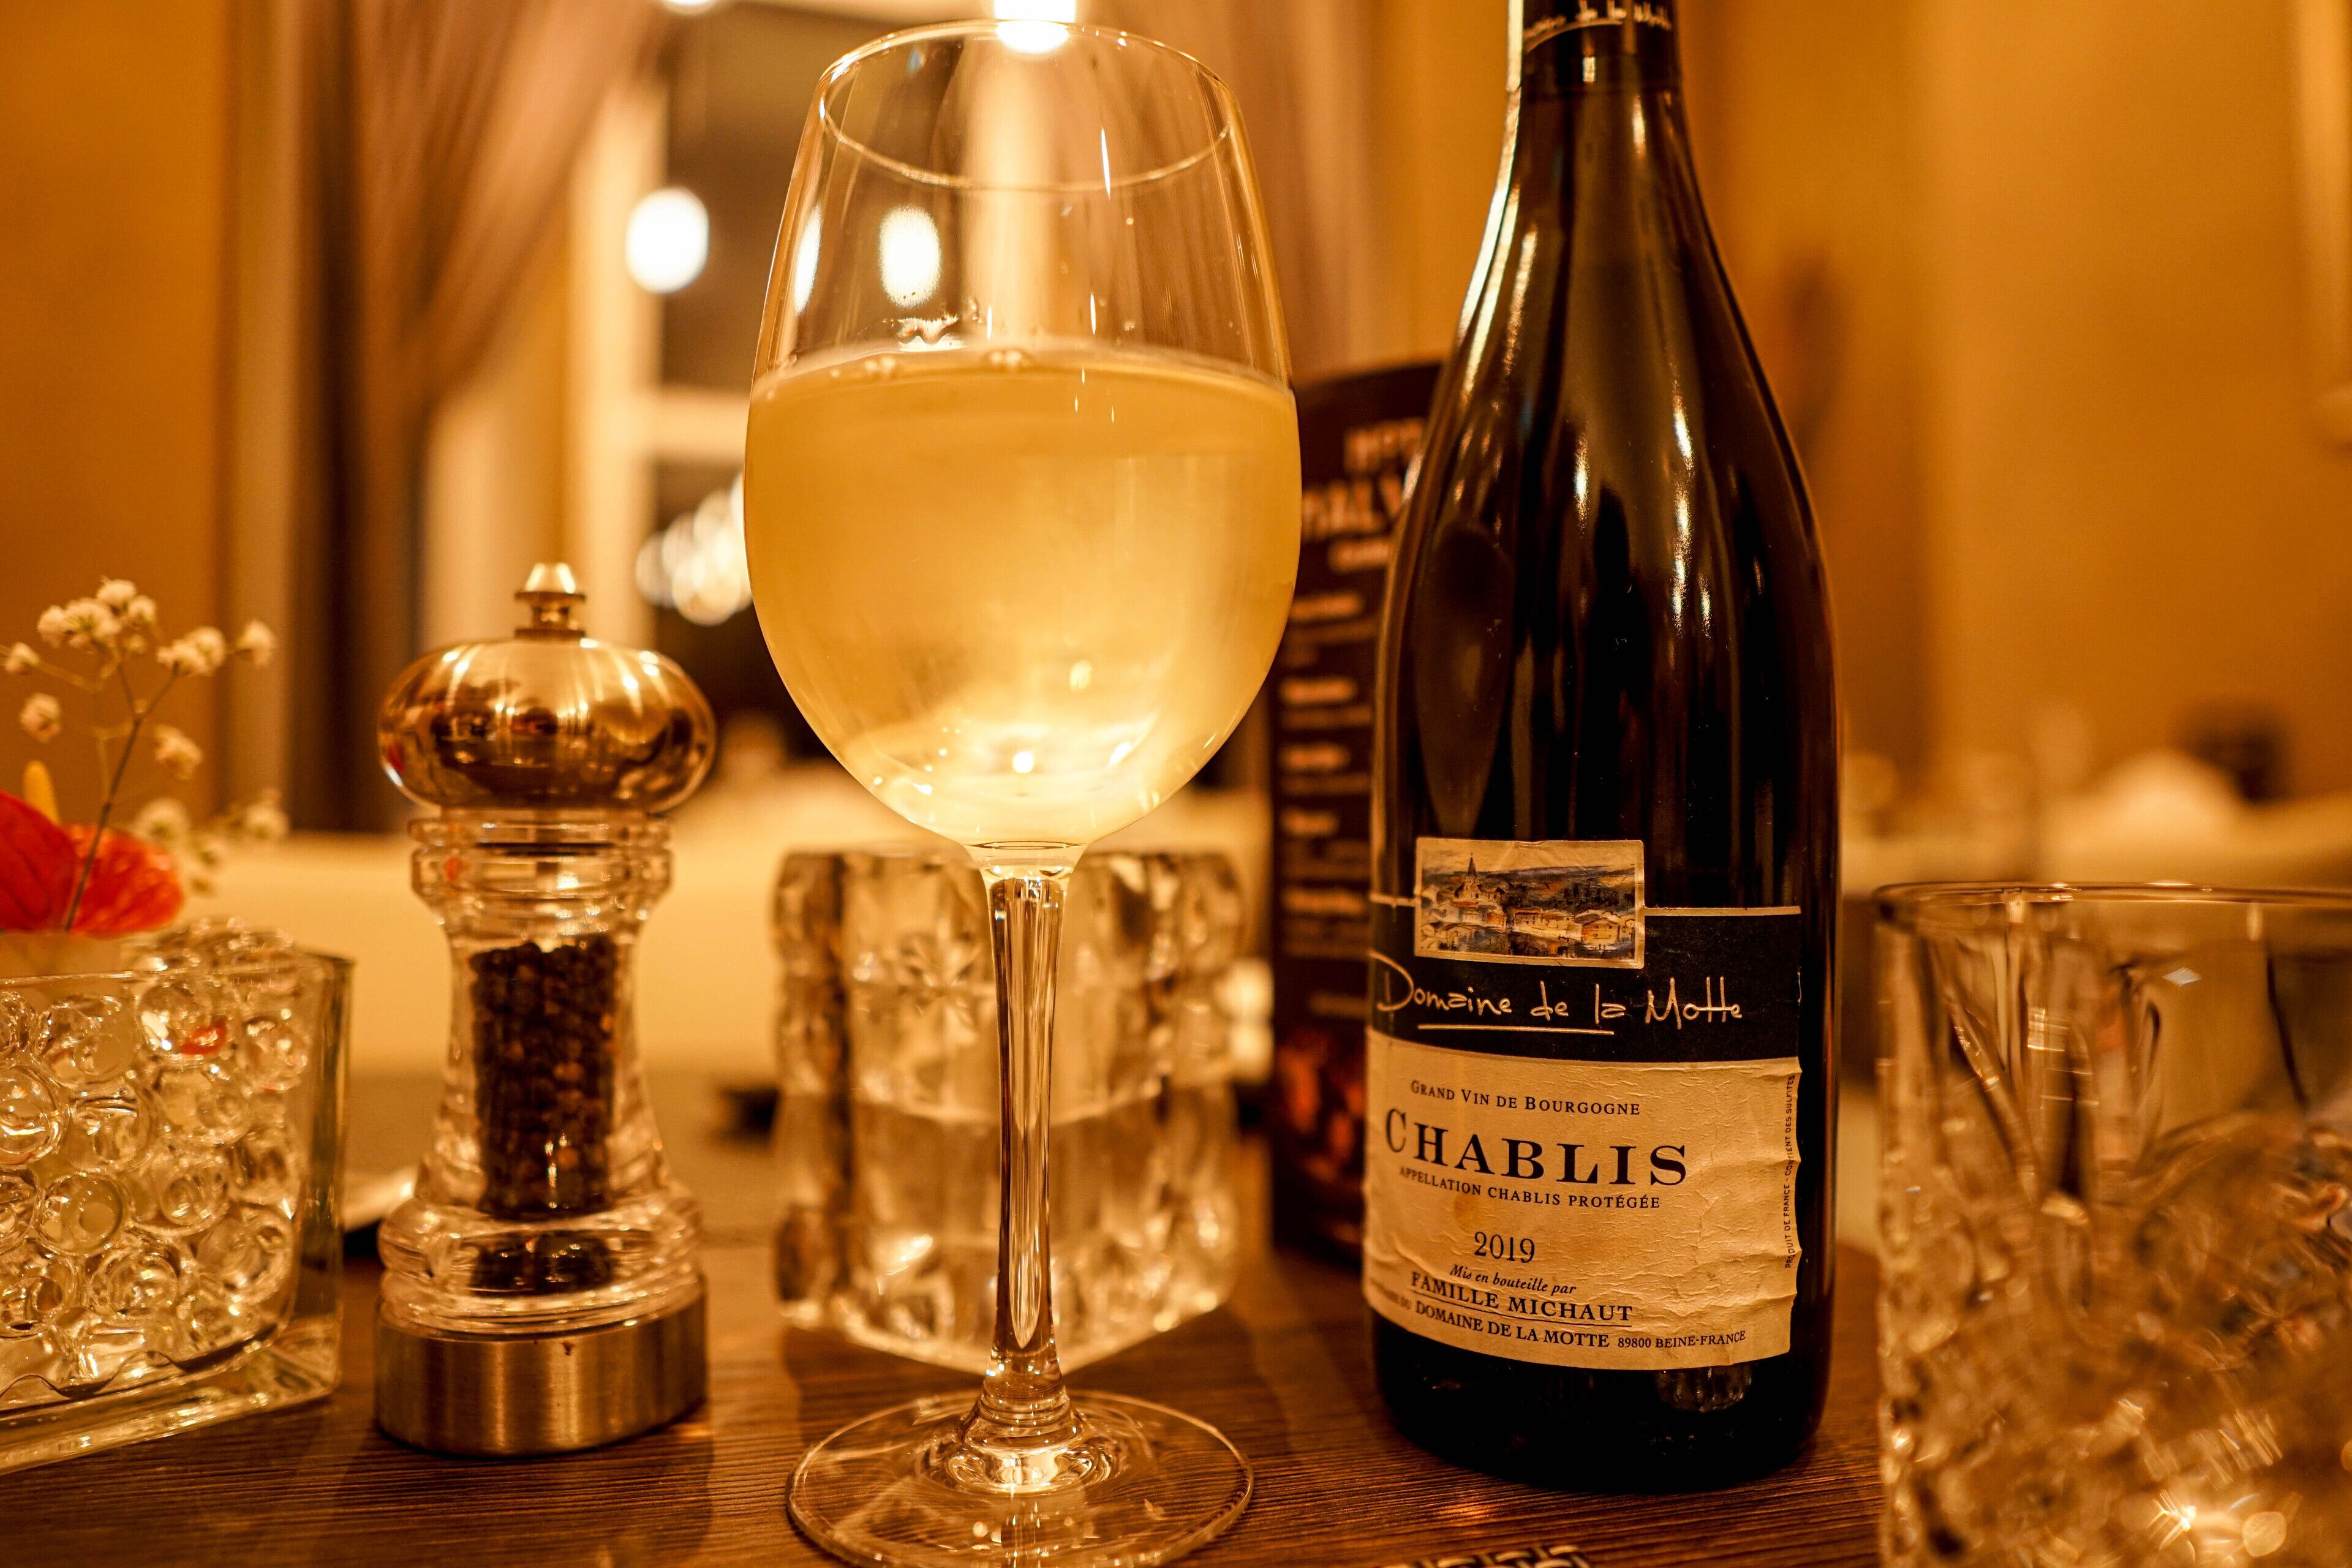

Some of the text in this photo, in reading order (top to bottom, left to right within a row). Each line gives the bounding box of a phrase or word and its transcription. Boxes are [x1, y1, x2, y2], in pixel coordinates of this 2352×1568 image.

[1369, 951, 1512, 1017] Domaine
[1530, 981, 1569, 1021] de
[1596, 984, 1626, 1024] la
[1645, 977, 1743, 1030] Motte
[1411, 1079, 1640, 1115] GRAND VIN DE BOURGOGNE
[1786, 1075, 1796, 1114] SULFITES
[1384, 1107, 1687, 1186] CHABLIS
[1785, 1136, 1795, 1176] CONTIENT
[1400, 1166, 1660, 1209] APPELLATION CHABLIS PROTÉGÉE
[1784, 1219, 1791, 1232] DE
[1473, 1231, 1536, 1264] 2019
[1411, 1271, 1499, 1310] FAMILLE
[1507, 1295, 1633, 1322] MICHAUT
[1450, 1264, 1577, 1297] Mis en bouteille par
[1415, 1300, 1483, 1333] DOMAINE
[1487, 1320, 1512, 1340] DE
[1516, 1326, 1539, 1343] LA
[1544, 1330, 1610, 1348] MOTTE
[1618, 1336, 1652, 1348] 89800
[1655, 1330, 1746, 1348] BEINE-FRANCE
